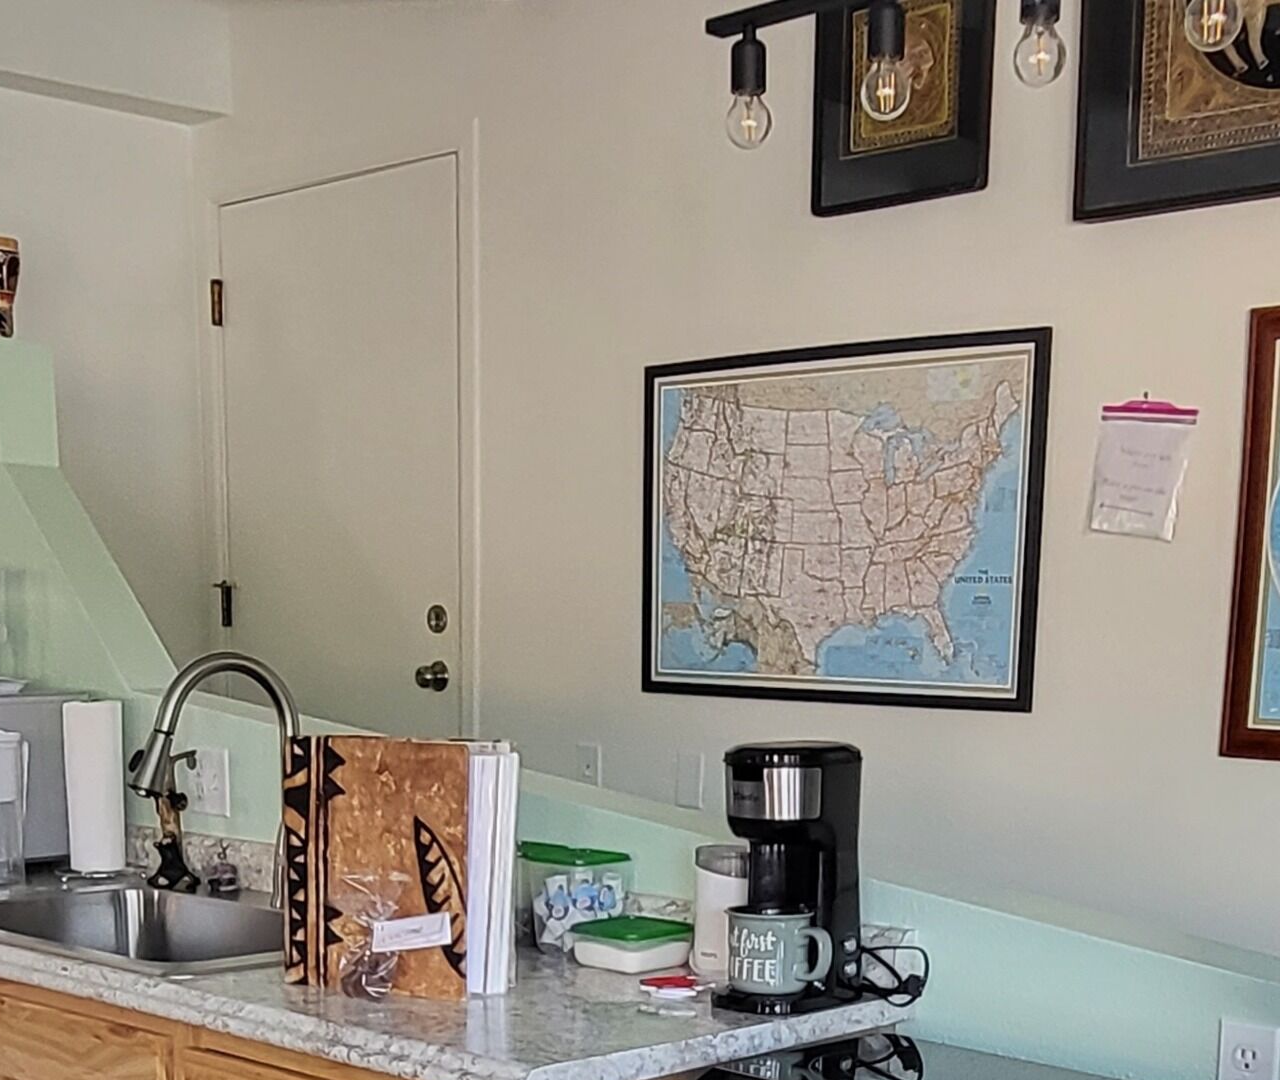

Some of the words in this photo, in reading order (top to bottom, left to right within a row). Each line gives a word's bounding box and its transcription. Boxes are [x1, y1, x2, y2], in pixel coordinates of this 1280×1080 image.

[954, 575, 984, 584] UNITED
[986, 575, 1013, 584] STATES
[740, 928, 777, 958] first
[731, 956, 777, 983] FFEE
